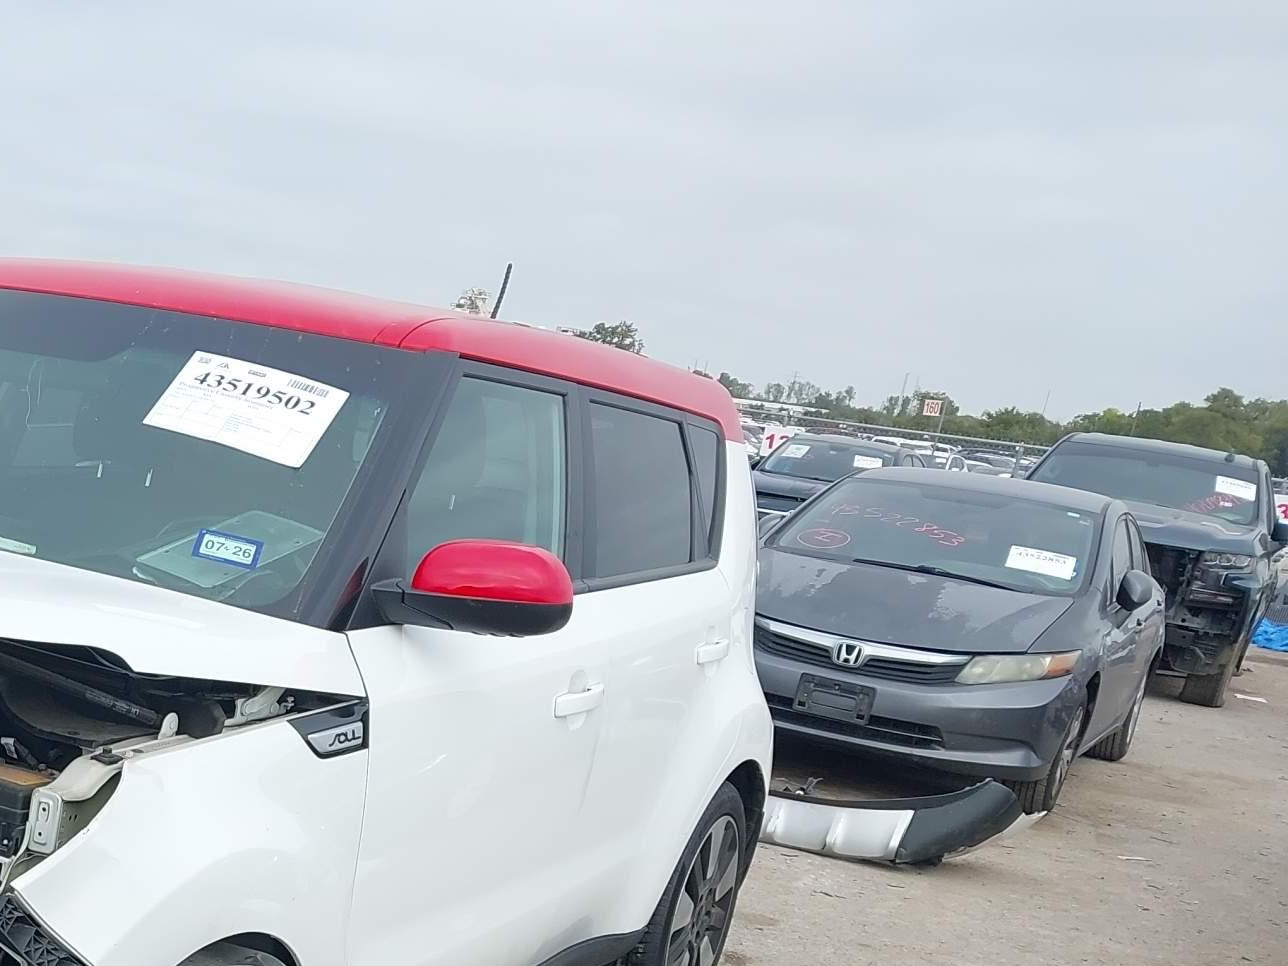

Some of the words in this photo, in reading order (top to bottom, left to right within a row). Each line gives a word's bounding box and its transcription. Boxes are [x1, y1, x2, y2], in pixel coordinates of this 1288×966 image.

[193, 371, 316, 415] 43519502
[204, 539, 226, 552] 07
[232, 545, 253, 559] 26
